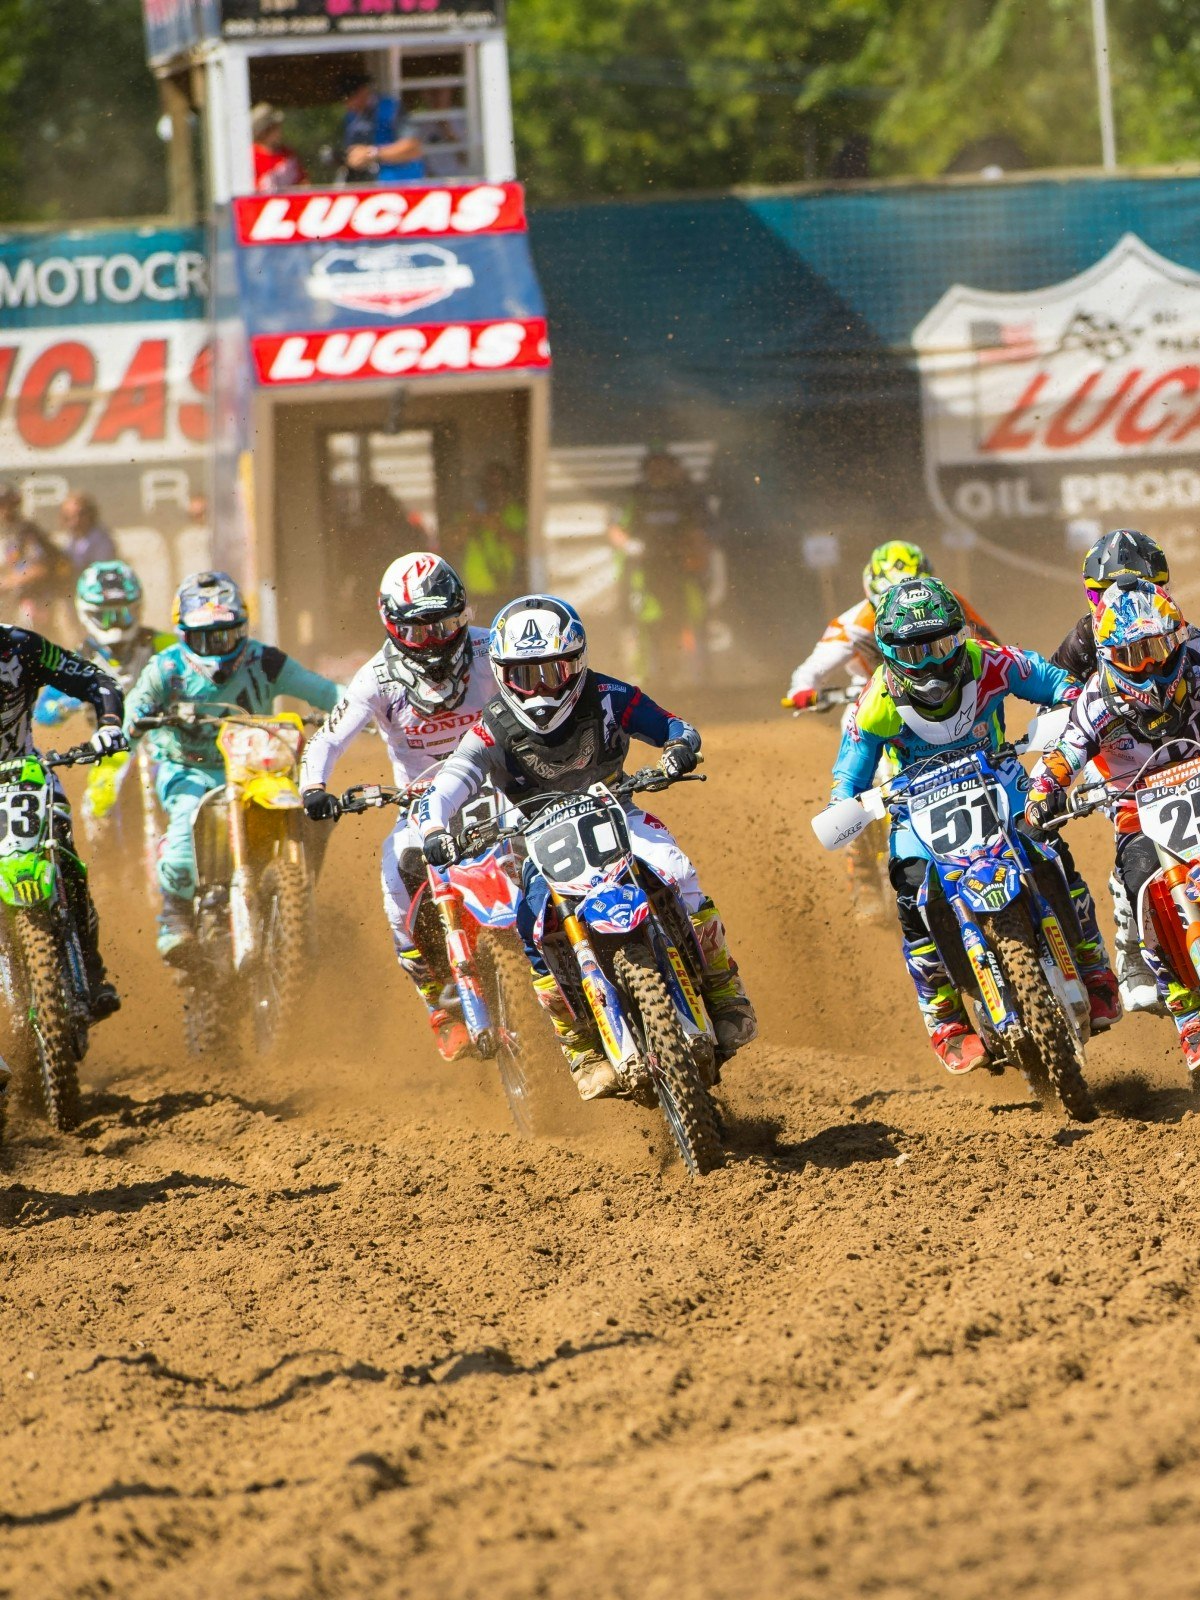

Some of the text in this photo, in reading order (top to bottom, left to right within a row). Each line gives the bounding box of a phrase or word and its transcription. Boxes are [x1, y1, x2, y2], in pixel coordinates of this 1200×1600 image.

[249, 186, 507, 241] LUCAS
[268, 322, 527, 381] LUCAS
[954, 478, 1050, 521] OIL
[913, 618, 945, 628] TOYOTA
[544, 806, 577, 830] LUCAS
[578, 800, 597, 814] OIL
[928, 778, 978, 804] LUCAS OIL
[534, 806, 633, 883] 80
[833, 821, 863, 845] ARC
[929, 788, 1001, 855] 51
[980, 882, 1005, 896] YAMAHA
[1044, 925, 1079, 981] PIRELLI
[667, 951, 701, 1015] PIRELLI
